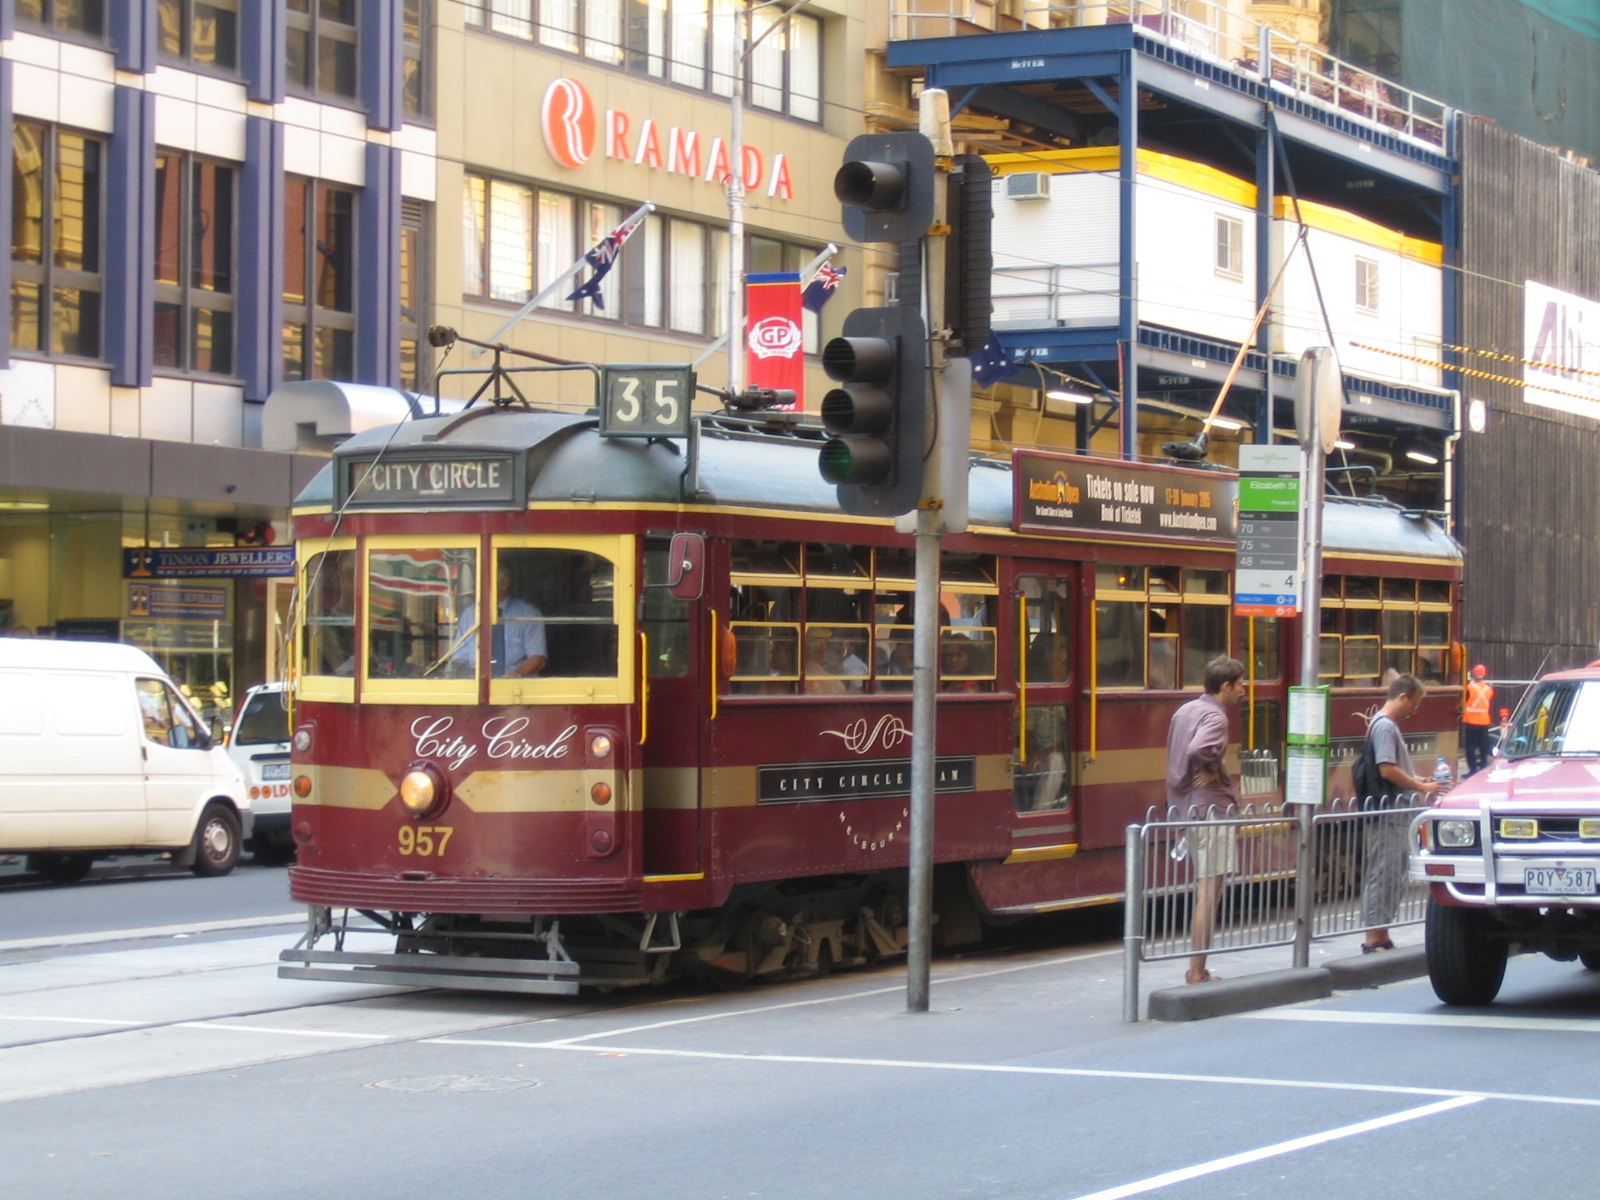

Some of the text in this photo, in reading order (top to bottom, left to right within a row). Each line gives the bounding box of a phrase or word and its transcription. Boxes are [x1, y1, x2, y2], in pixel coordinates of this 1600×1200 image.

[605, 109, 793, 199] RAMADA
[761, 328, 788, 344] GP
[371, 462, 500, 491] CITY CIRCLE
[1086, 473, 1112, 500] Tickets
[1113, 482, 1123, 501] on
[1124, 479, 1139, 503] sale
[1140, 484, 1155, 504] now
[1250, 481, 1297, 490] Elizabeth St
[1101, 503, 1114, 522] Book
[1241, 524, 1254, 534] 70
[1240, 540, 1253, 550] 75
[159, 551, 291, 566] TINSON JEWELLERS
[1240, 556, 1253, 567] 48
[1284, 575, 1294, 588] 4
[410, 715, 578, 771] City Circle
[780, 777, 824, 791] CITY
[839, 773, 904, 788] CIRCLE
[398, 825, 453, 856] 957
[1527, 871, 1593, 887] PQY 587
